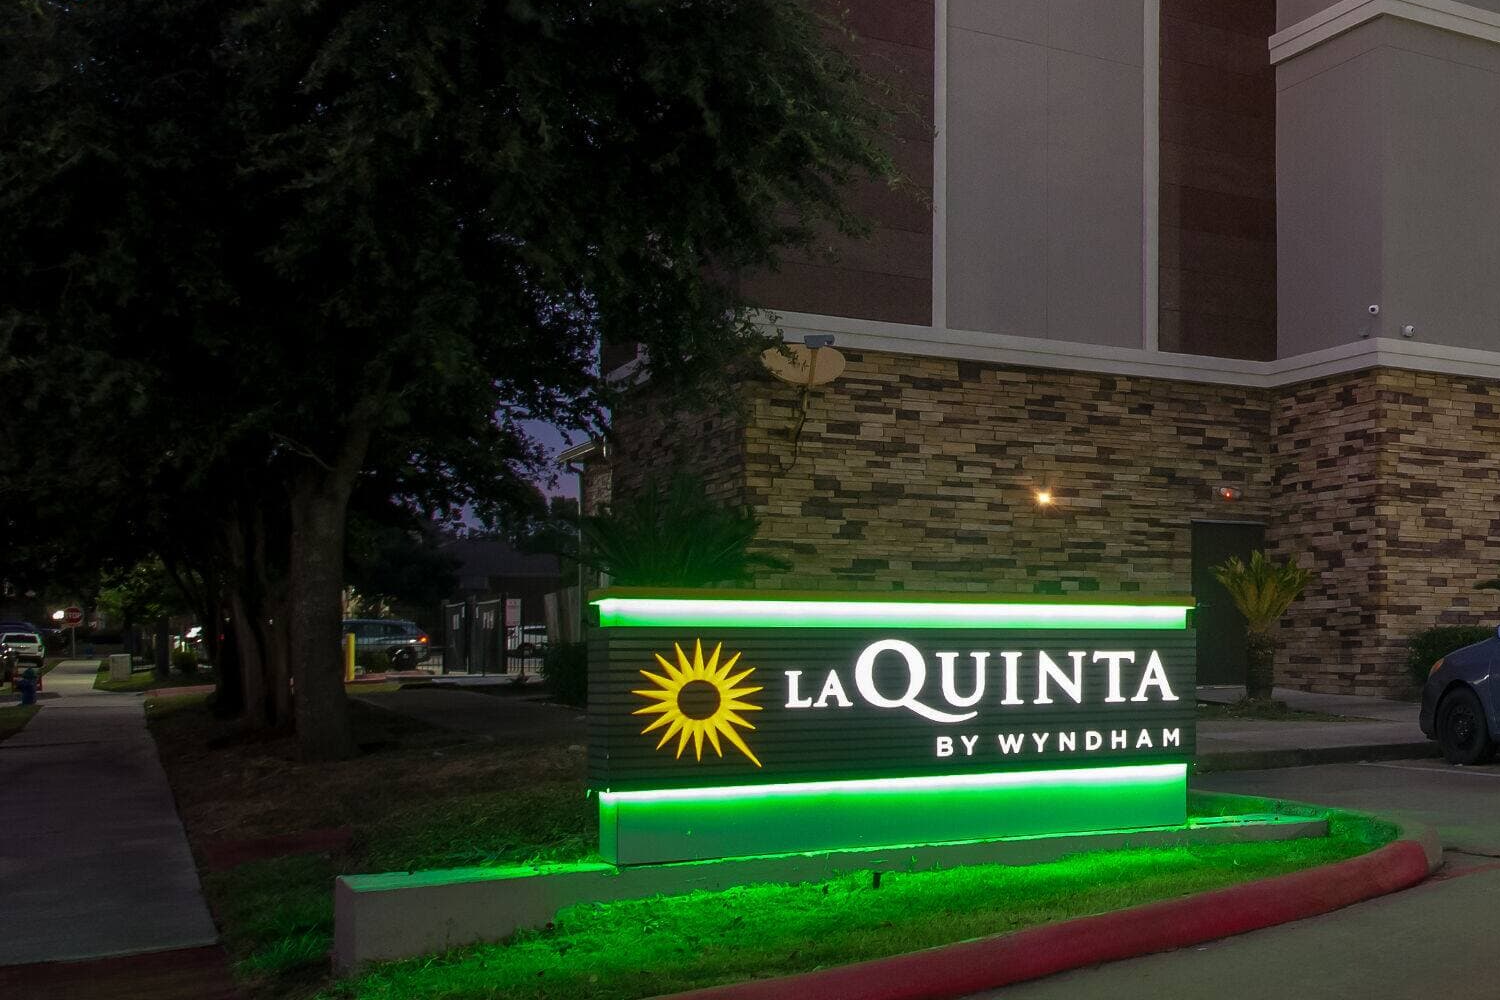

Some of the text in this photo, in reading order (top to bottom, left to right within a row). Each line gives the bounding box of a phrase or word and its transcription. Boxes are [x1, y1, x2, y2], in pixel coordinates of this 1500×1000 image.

[784, 638, 1181, 724] LA QUINTA
[935, 726, 1181, 758] BY WYNDHAM
